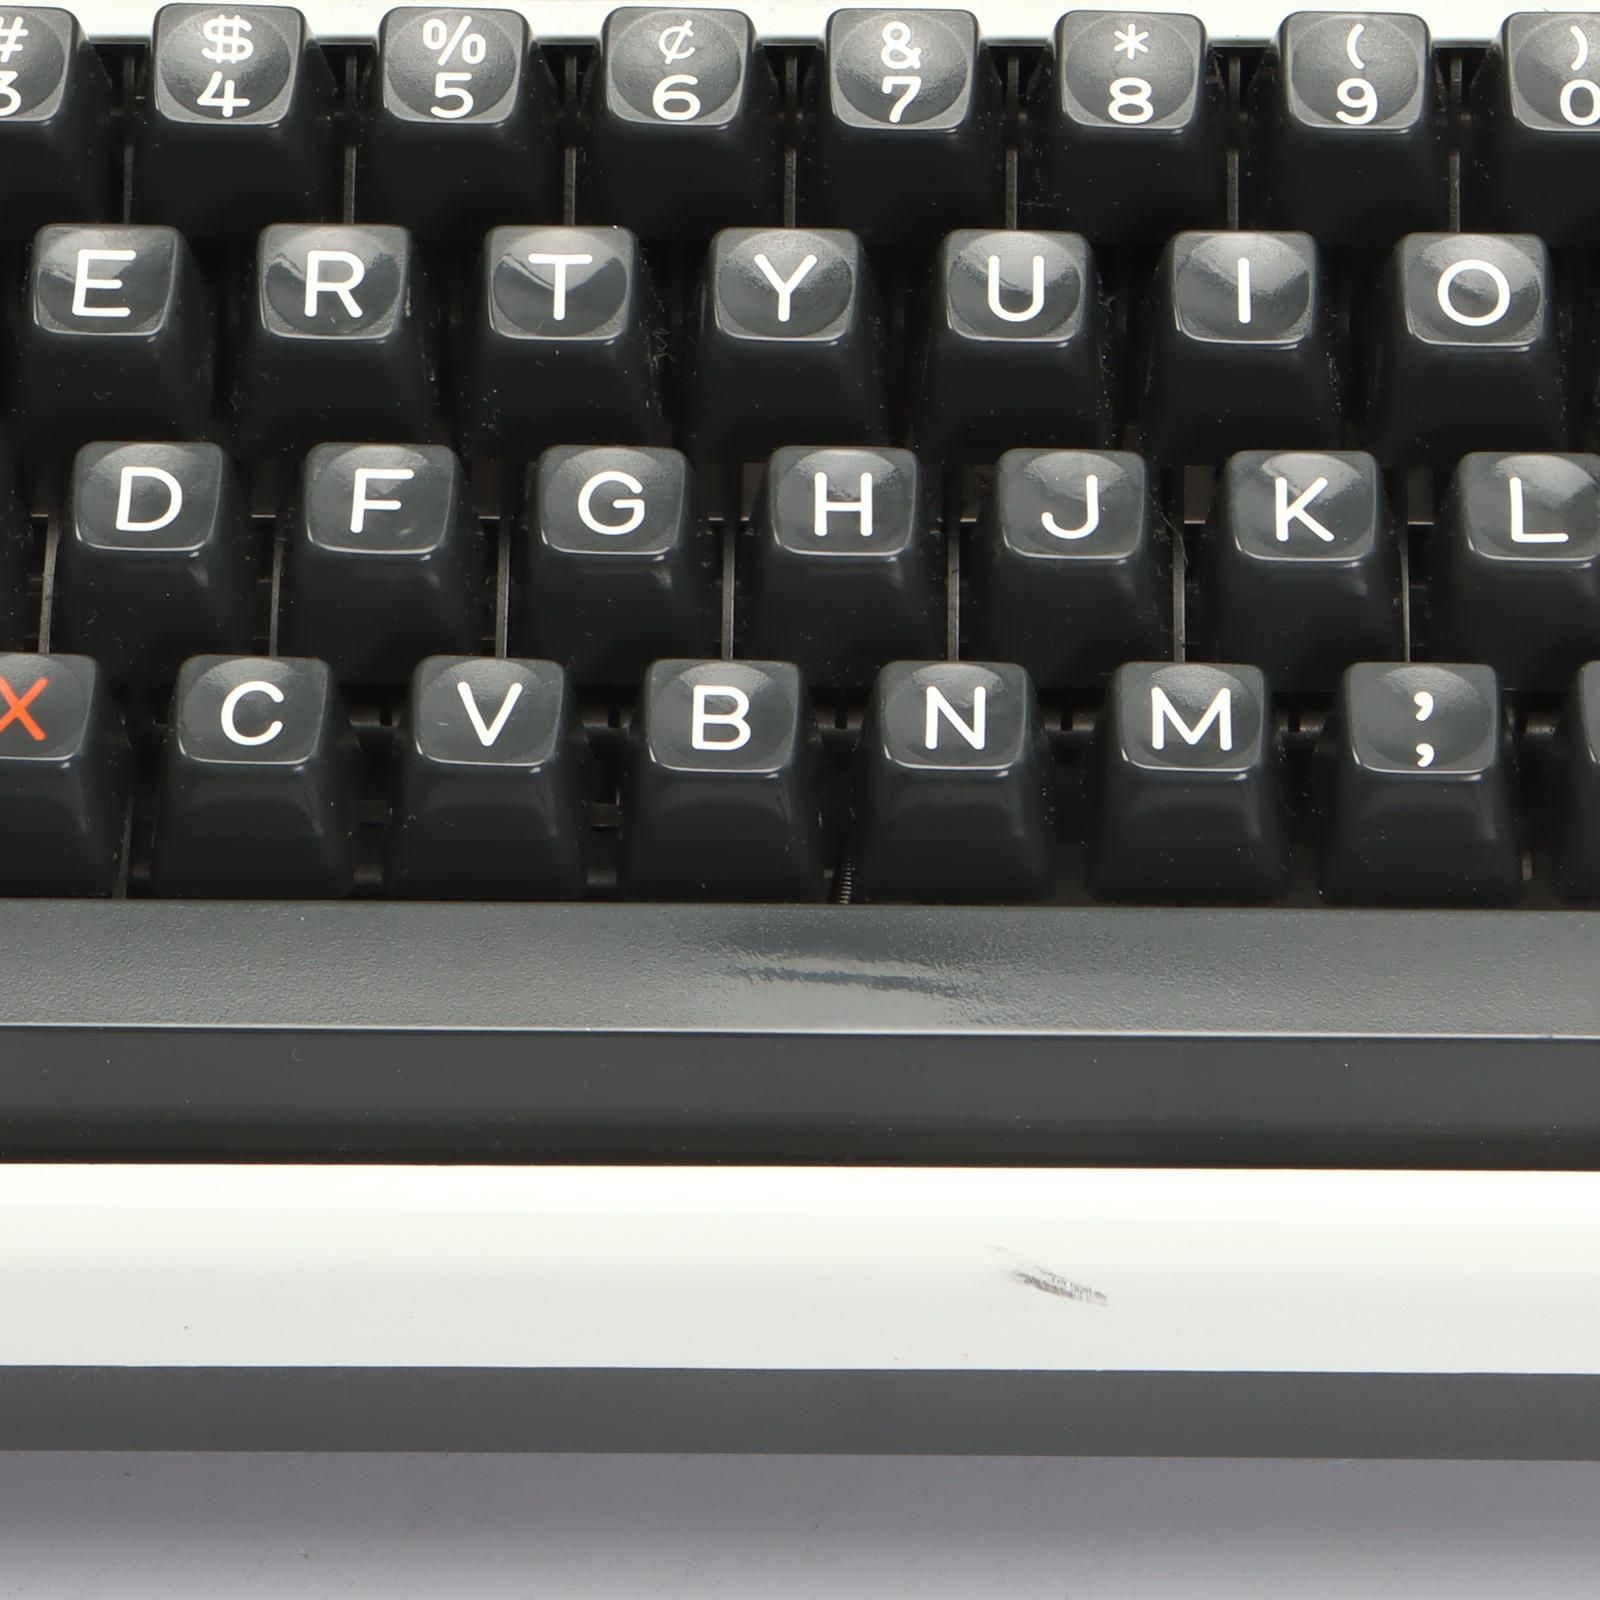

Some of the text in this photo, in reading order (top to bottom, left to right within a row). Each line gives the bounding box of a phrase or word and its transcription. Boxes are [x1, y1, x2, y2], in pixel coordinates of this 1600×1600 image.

[201, 14, 254, 64] $
[422, 15, 486, 66] %
[880, 20, 922, 70] &
[1346, 23, 1365, 70] (
[1569, 25, 1589, 71] )
[197, 71, 250, 117] 4
[430, 72, 474, 119] 5
[652, 74, 701, 121] 6
[882, 75, 922, 123] 7
[1108, 77, 1154, 124] 8
[1336, 78, 1378, 125] 9
[72, 248, 137, 317] E
[304, 250, 365, 318] R
[528, 253, 593, 321] T
[753, 253, 818, 322] Y
[988, 255, 1045, 322] U
[1237, 257, 1251, 323] I
[1437, 259, 1510, 326] O
[116, 466, 182, 531] D
[350, 468, 414, 533] F
[578, 471, 645, 535] G
[814, 472, 873, 536] H
[1041, 474, 1099, 539] J
[1275, 477, 1334, 542] K
[1509, 477, 1569, 543] L
[221, 680, 284, 746] C
[457, 681, 523, 746] V
[692, 685, 751, 750] B
[925, 686, 986, 750] N
[1151, 687, 1232, 751] M
